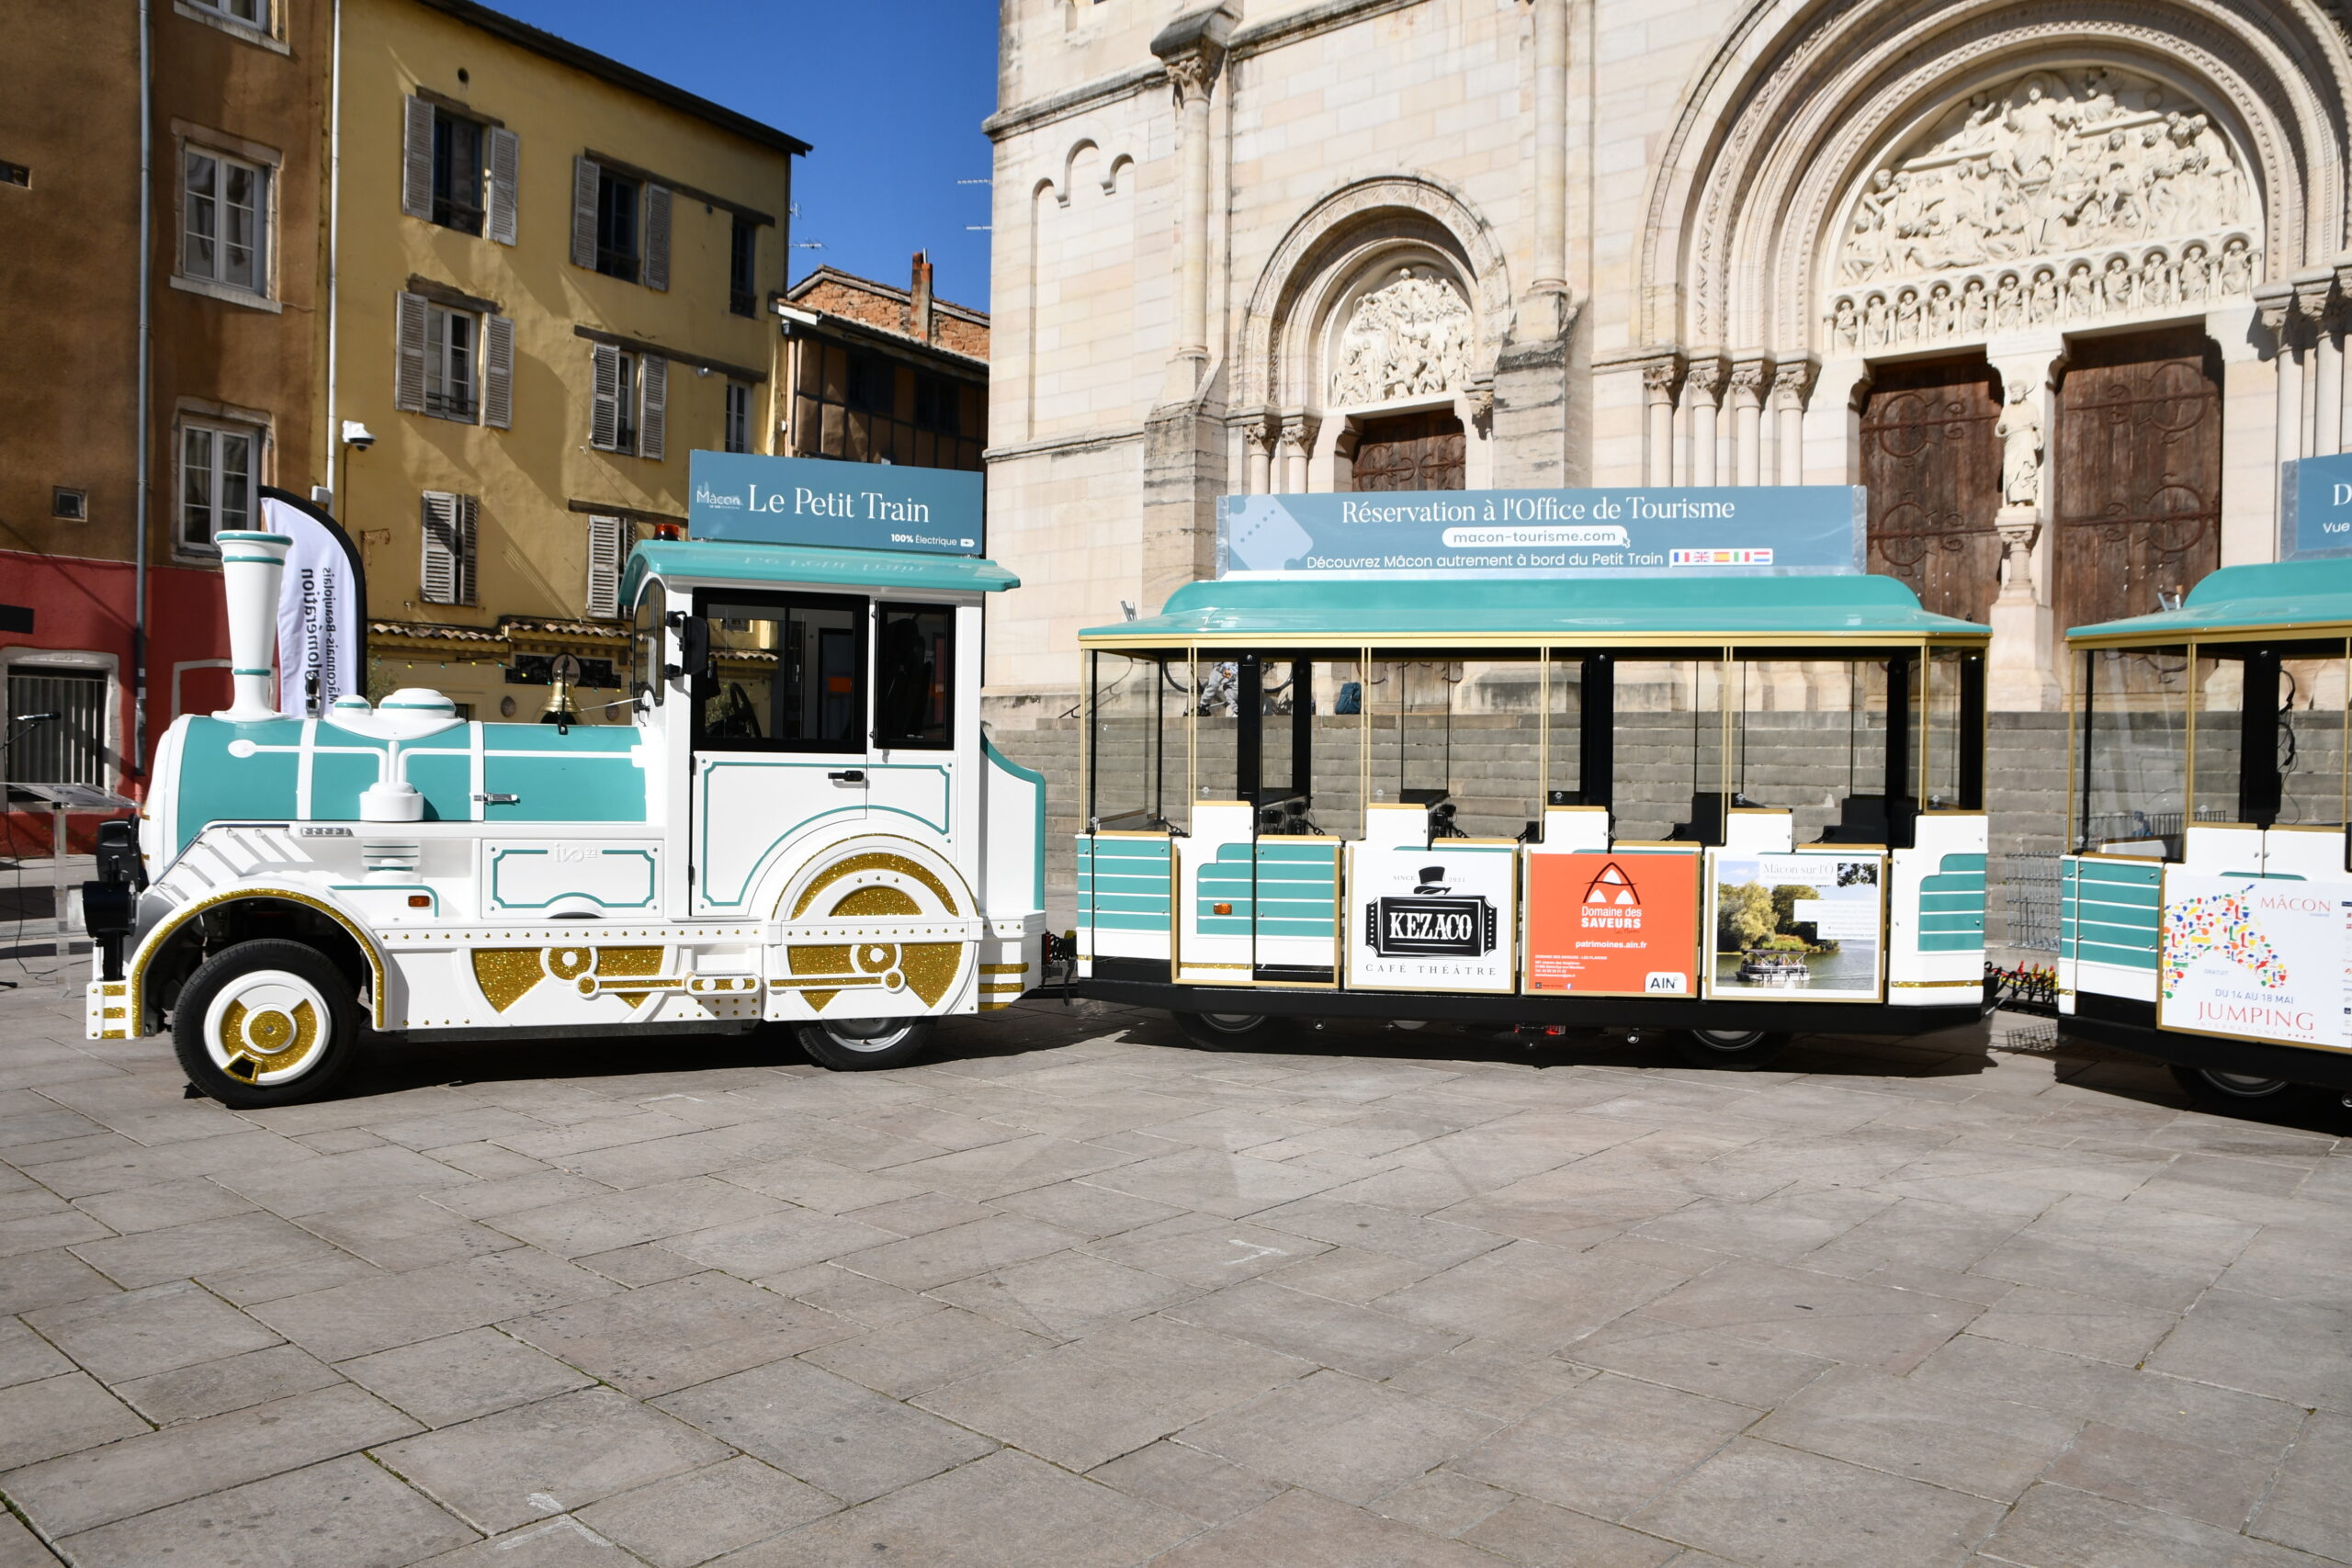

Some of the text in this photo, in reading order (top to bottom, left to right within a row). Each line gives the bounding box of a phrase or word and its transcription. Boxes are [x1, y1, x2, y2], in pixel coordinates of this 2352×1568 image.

[696, 490, 741, 506] Mâcon
[749, 484, 930, 523] Le Petit Train
[1342, 496, 1736, 524] Réservation à l'Office de Tourisme
[891, 533, 957, 547] 100% Électrique
[1453, 530, 1617, 543] macon-tourisme.com
[1307, 552, 1663, 569] Découvrez Mâcon autrement à bord du Petit Train
[1763, 863, 1798, 874] Mâcon
[1801, 866, 1817, 874] sur
[2260, 895, 2331, 911] MÂCON
[1581, 906, 1642, 917] Domaine des
[1389, 912, 1473, 941] KEZACO
[1581, 917, 1642, 929] SAVEURS
[1576, 940, 1647, 950] patrimoines.ain.fr
[1365, 963, 1497, 976] CAFÉ THÉÂTRE
[1650, 977, 1676, 989] AIN
[2215, 988, 2294, 1005] DU 14 AU 18 MAI
[2199, 1001, 2314, 1031] JUMPING
